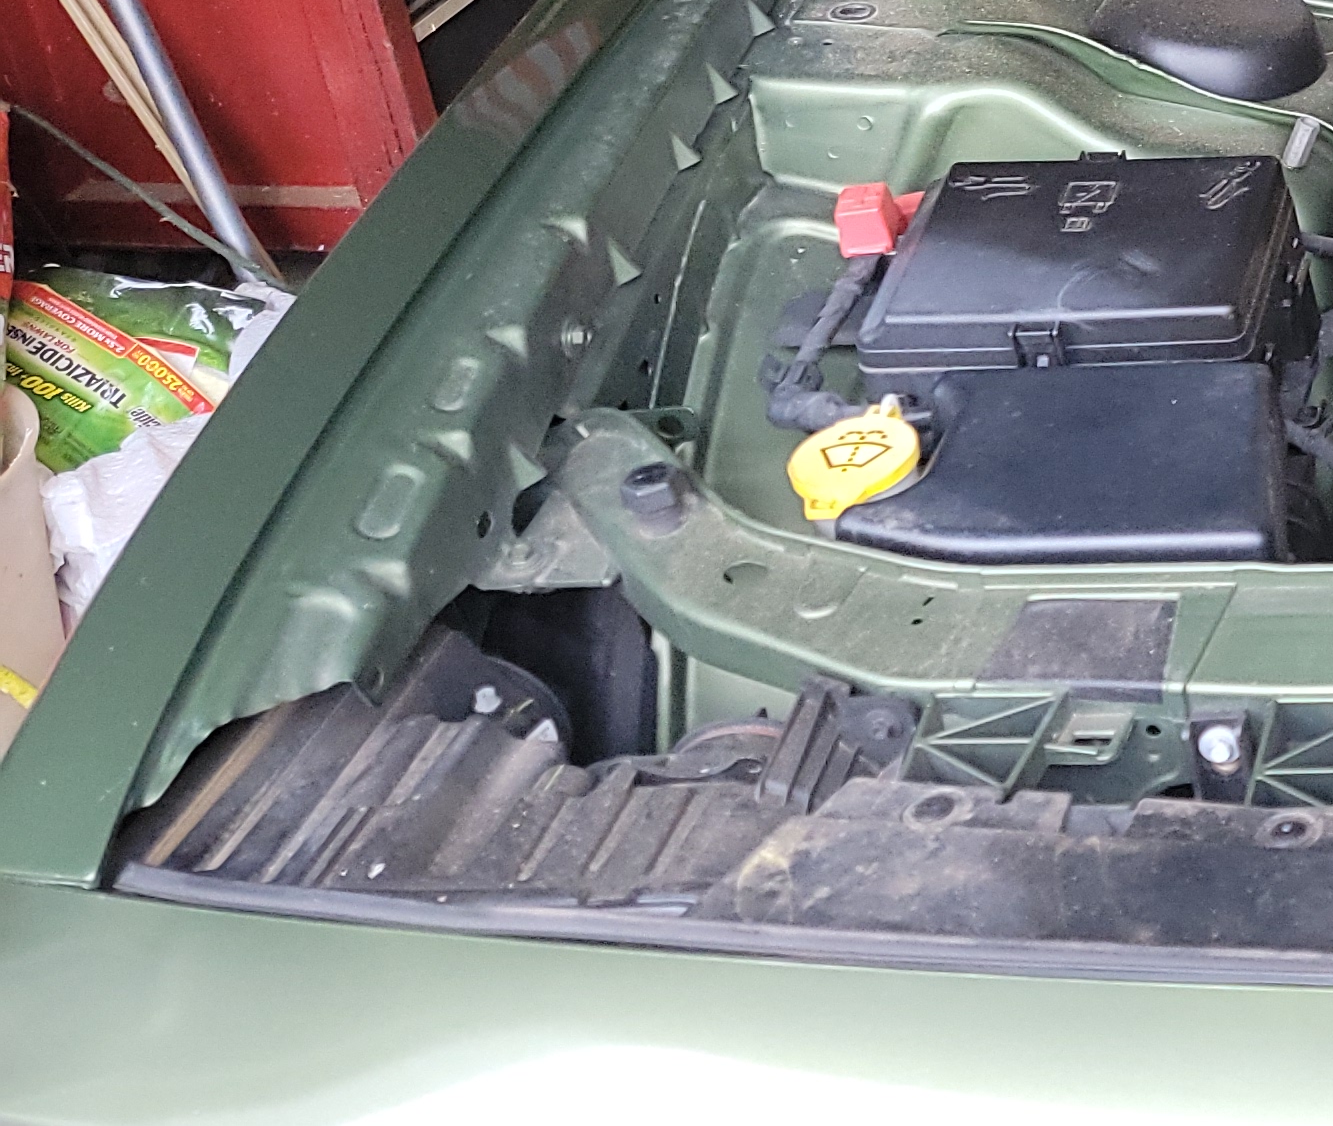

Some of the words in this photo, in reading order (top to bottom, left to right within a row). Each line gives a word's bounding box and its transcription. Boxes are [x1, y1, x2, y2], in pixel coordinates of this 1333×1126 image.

[6, 323, 37, 347] INSE
[76, 318, 105, 343] MORE
[54, 339, 76, 354] FOR
[26, 341, 127, 409] TRIAZICIDE
[60, 392, 92, 412] Kills
